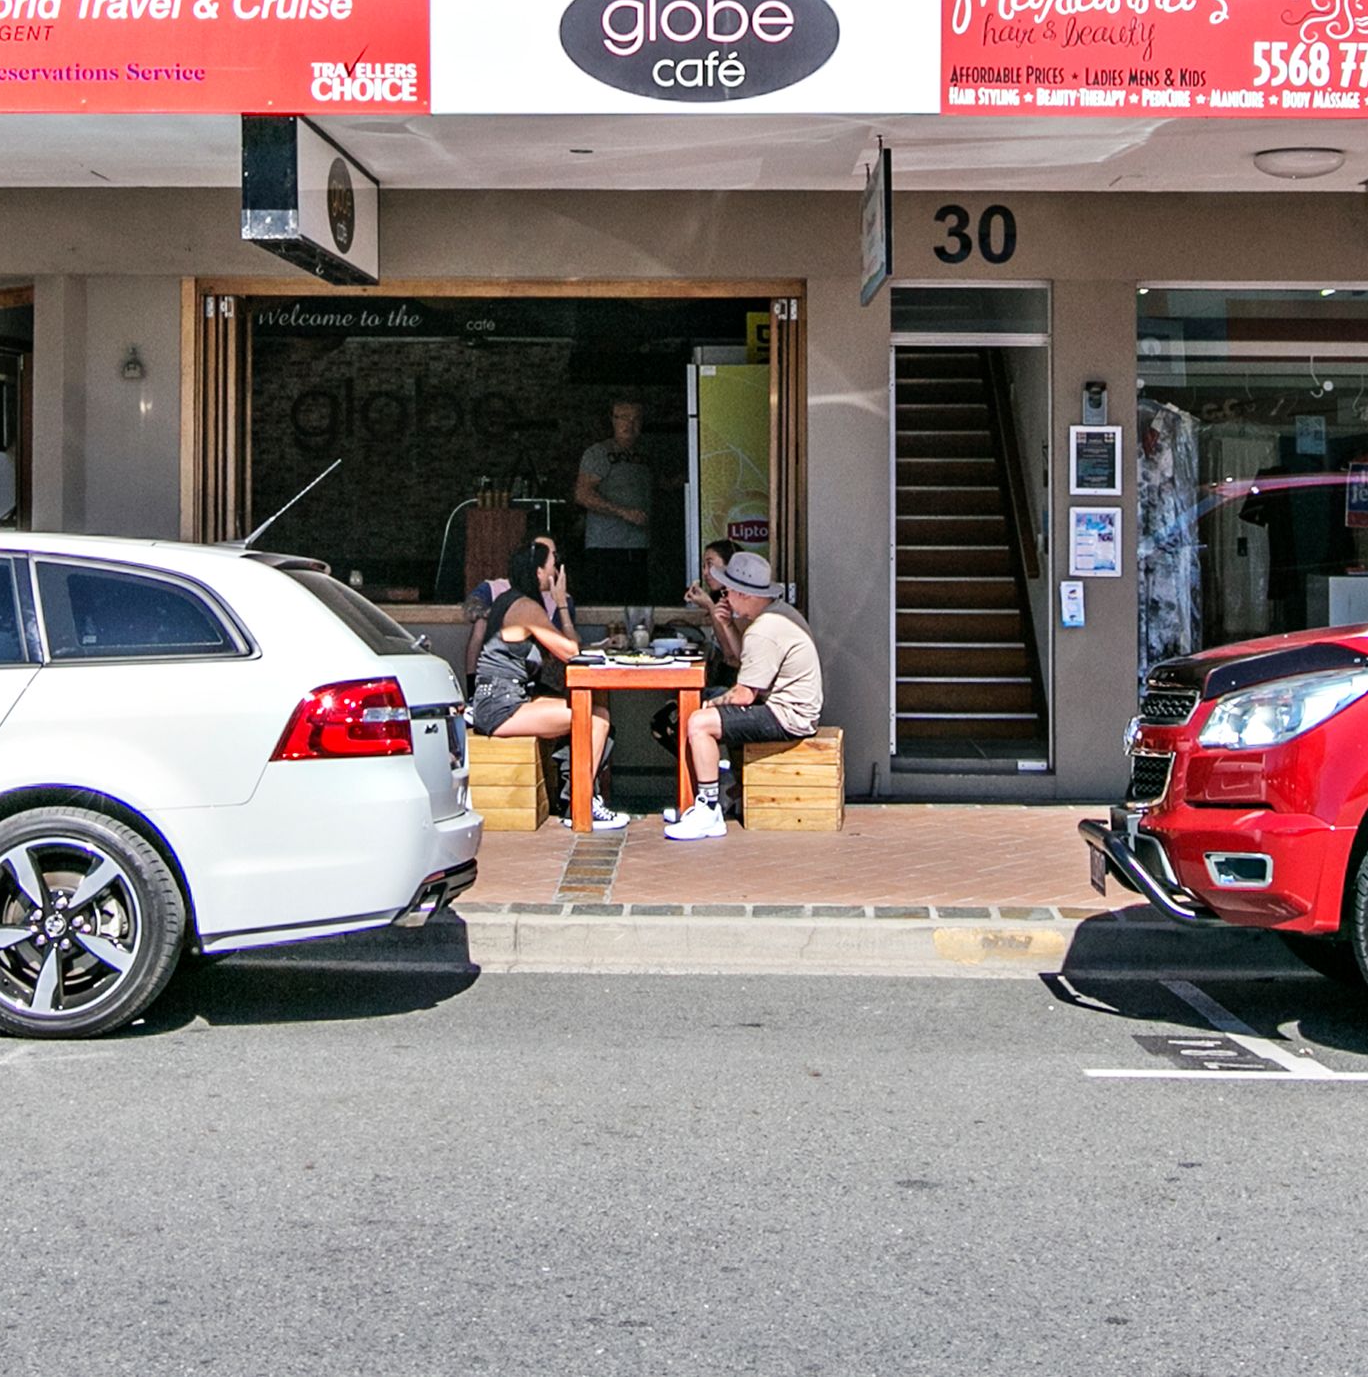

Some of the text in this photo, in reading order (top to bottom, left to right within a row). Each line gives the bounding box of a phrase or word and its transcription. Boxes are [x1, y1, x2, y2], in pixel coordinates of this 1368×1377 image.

[982, 14, 1156, 61] hair beauty
[126, 62, 205, 83] Service
[310, 61, 417, 80] TRAVELLERS
[652, 50, 746, 87] café
[950, 66, 1207, 87] AFFORDABLE PRICES LADIES MENS & KIDS
[1253, 42, 1330, 87] 5568
[310, 77, 417, 102] CHOICE
[949, 88, 975, 106] HAIR
[977, 88, 1020, 107] STYLING
[1282, 90, 1310, 109] BODY
[1312, 90, 1360, 109] MASSAGE
[933, 204, 1018, 264] 30
[258, 304, 422, 328] Welcome to the
